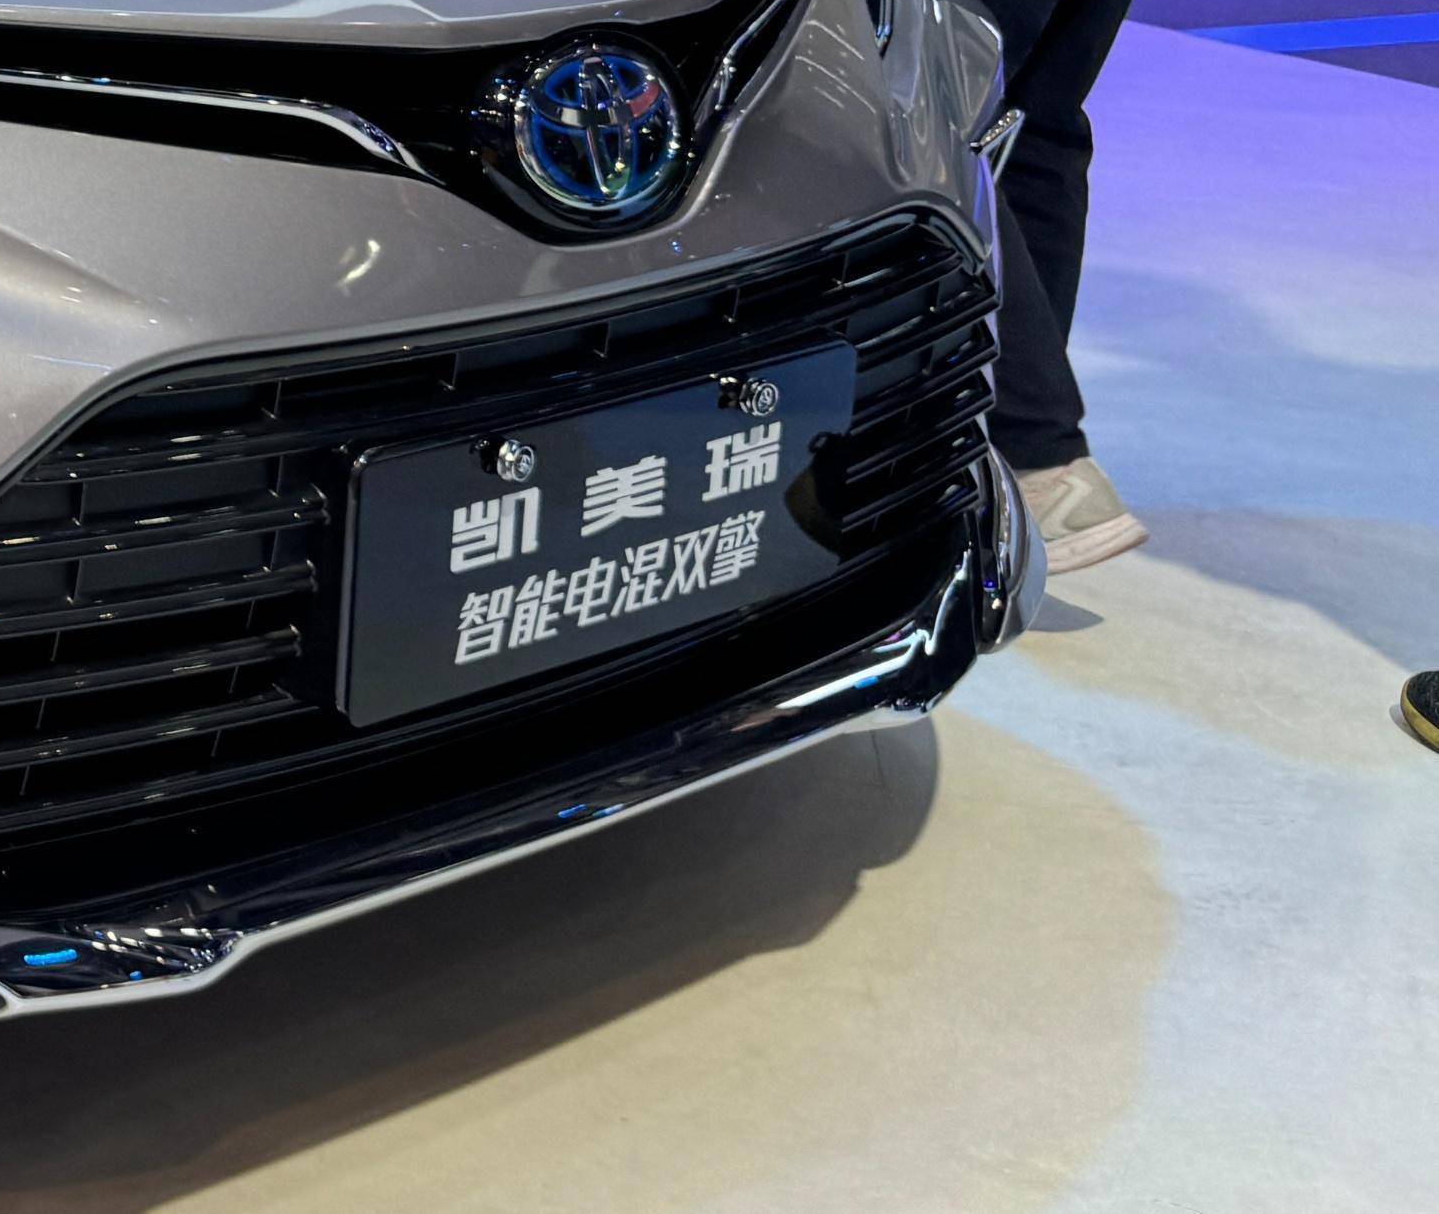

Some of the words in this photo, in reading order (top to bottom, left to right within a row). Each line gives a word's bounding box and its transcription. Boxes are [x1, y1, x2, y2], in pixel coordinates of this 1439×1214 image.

[450, 422, 783, 573] 凯美瑞
[455, 510, 765, 664] 智能电混双擎
